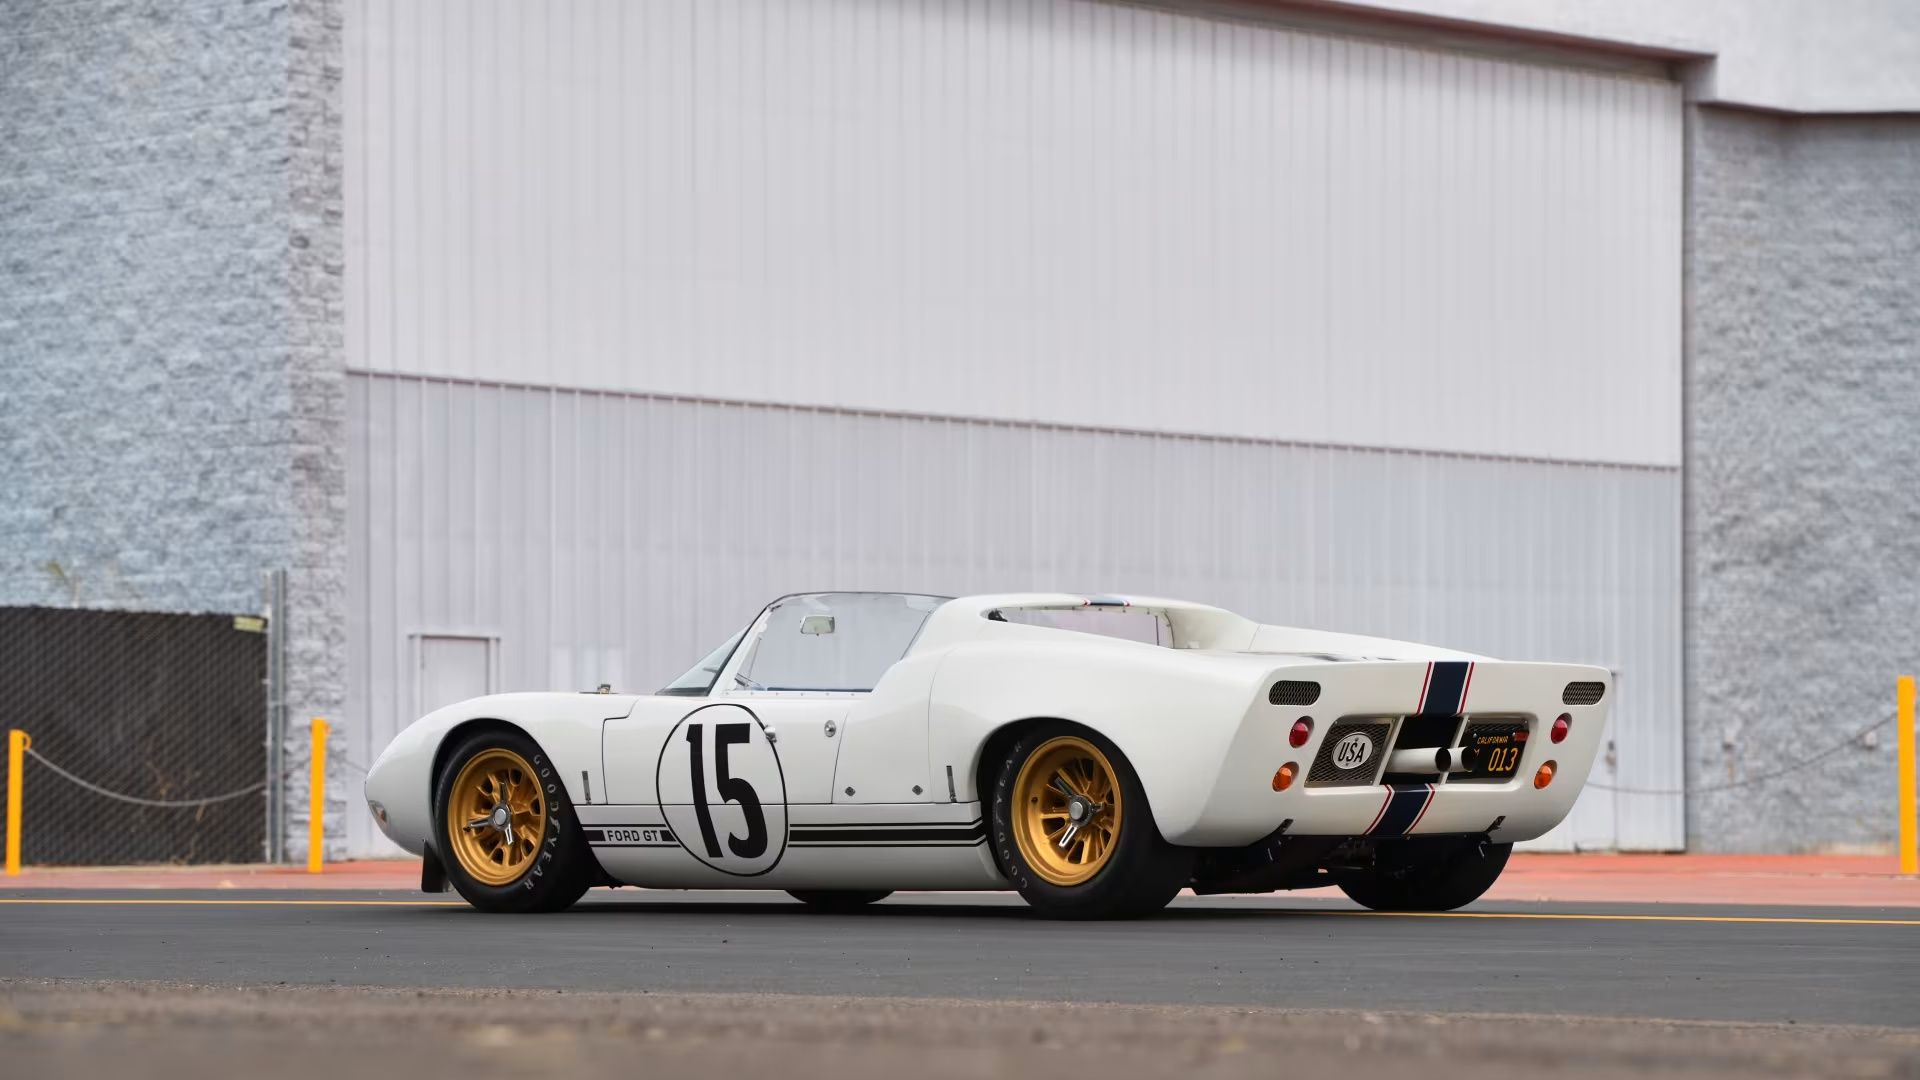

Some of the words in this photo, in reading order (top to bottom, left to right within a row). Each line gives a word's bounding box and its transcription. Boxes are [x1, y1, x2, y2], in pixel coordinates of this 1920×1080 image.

[1477, 736, 1508, 745] CALIFORNIA
[1338, 742, 1365, 762] USA
[1488, 748, 1518, 771] 013
[686, 723, 768, 858] 15
[524, 754, 561, 890] GOODYEAR
[607, 830, 640, 842] FORD
[643, 830, 658, 842] GT
